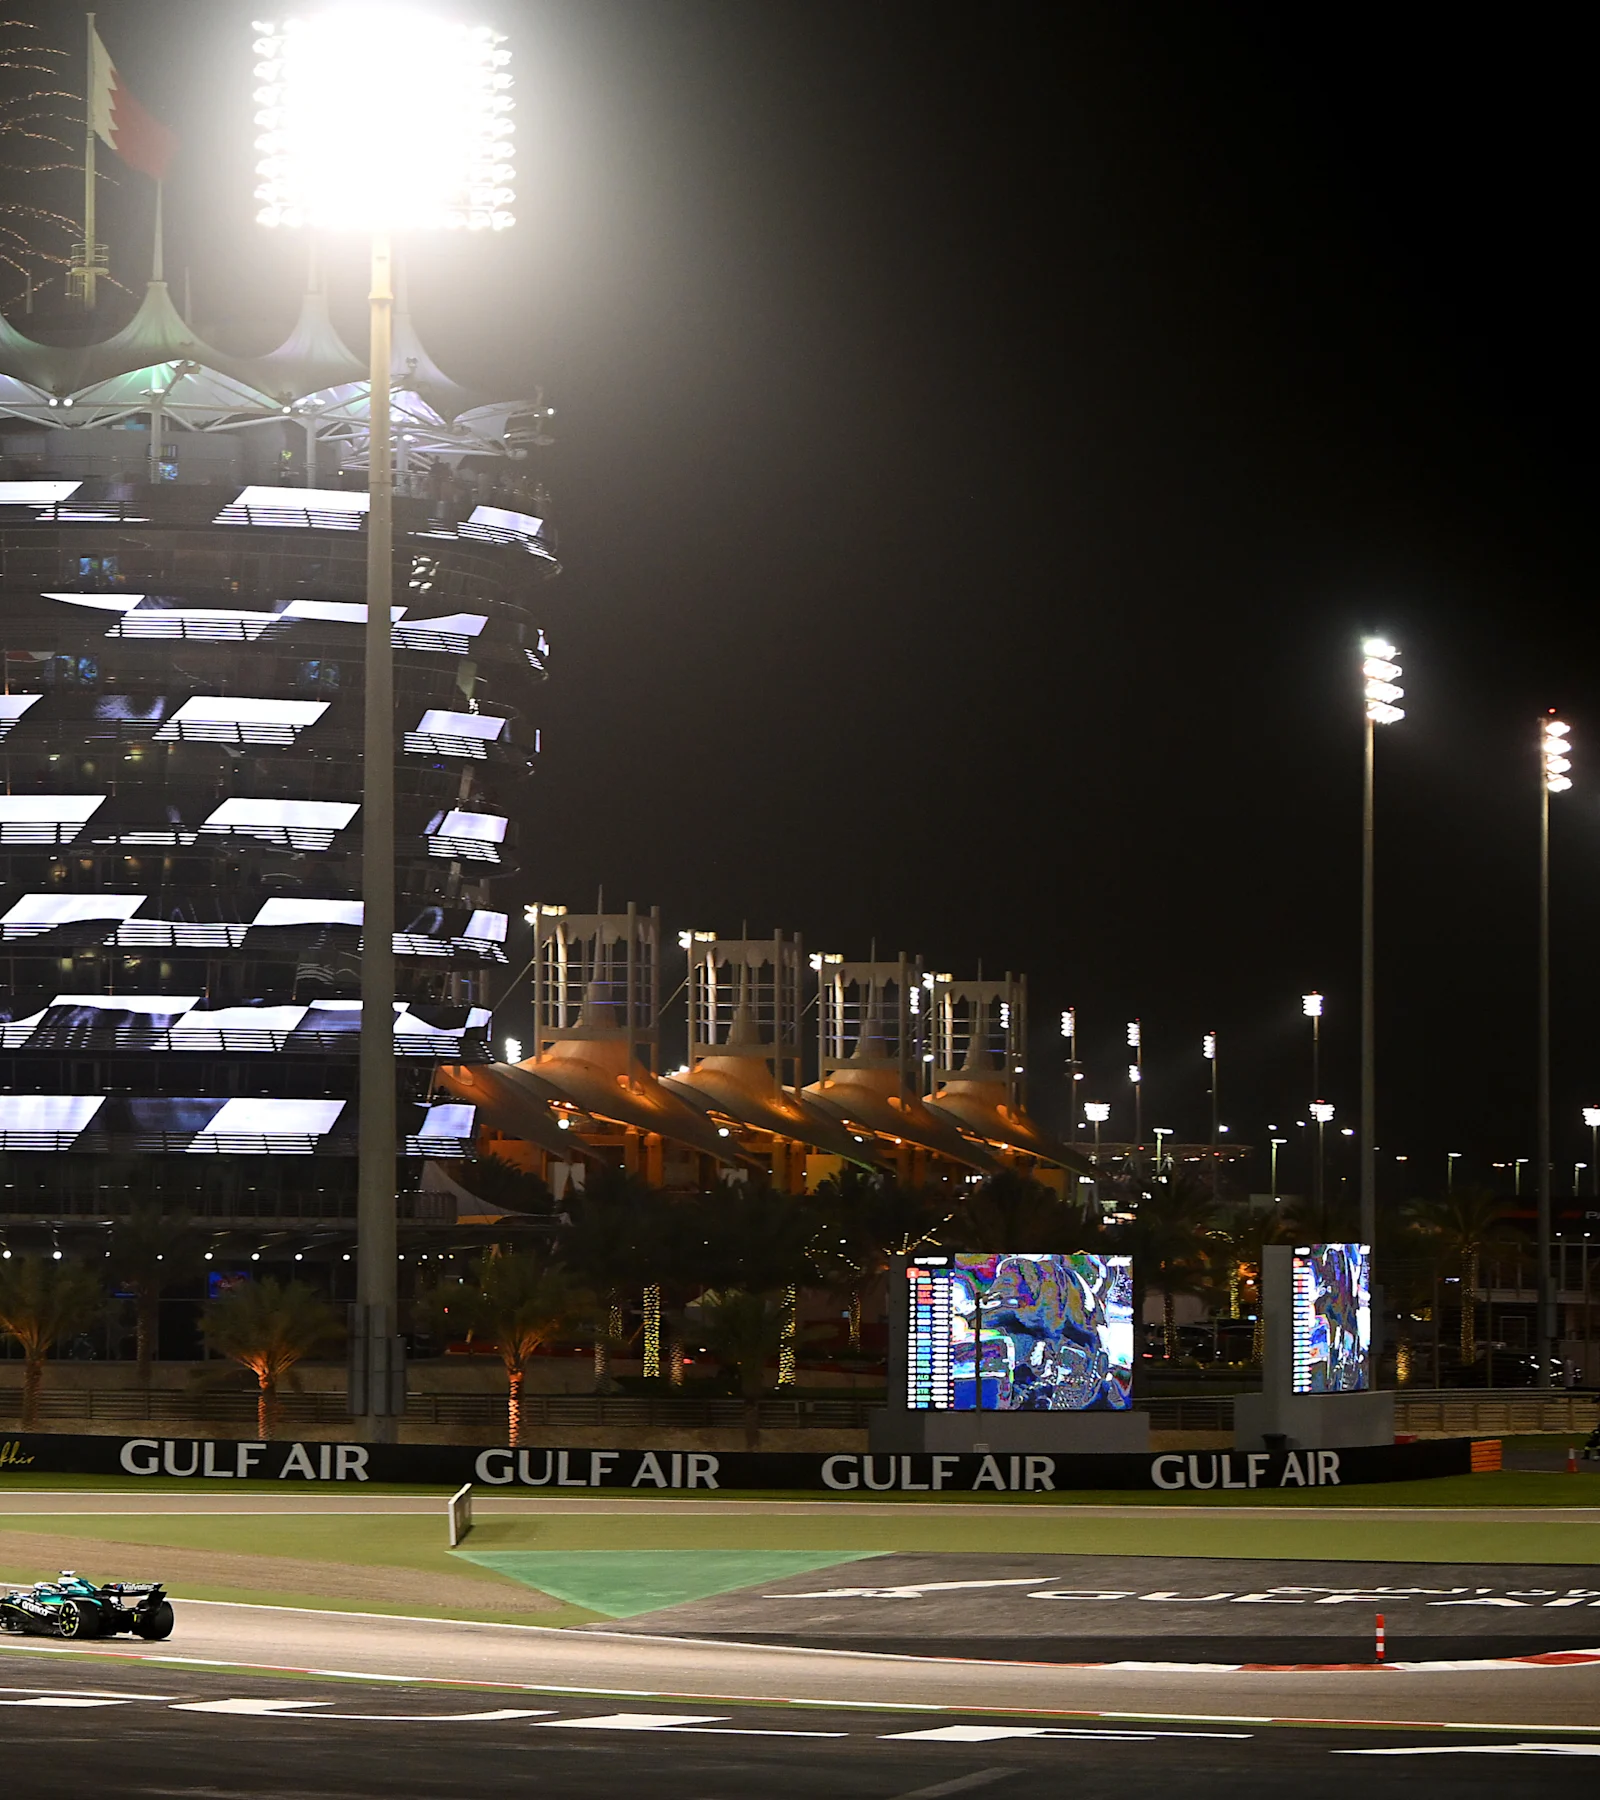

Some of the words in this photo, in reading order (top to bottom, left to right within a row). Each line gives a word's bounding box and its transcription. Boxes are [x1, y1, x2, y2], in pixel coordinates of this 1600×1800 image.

[119, 1439, 267, 1477] GULF
[279, 1443, 369, 1481] AIR
[475, 1449, 620, 1487] GULF
[631, 1452, 720, 1489] AIR
[821, 1454, 960, 1490] GULF
[972, 1454, 1056, 1490] AIR
[1151, 1454, 1270, 1489] GULF
[1280, 1451, 1341, 1486] AIR
[21, 1600, 49, 1616] aramco
[1026, 1590, 1410, 1604] GULF
[1426, 1598, 1600, 1607] AI
